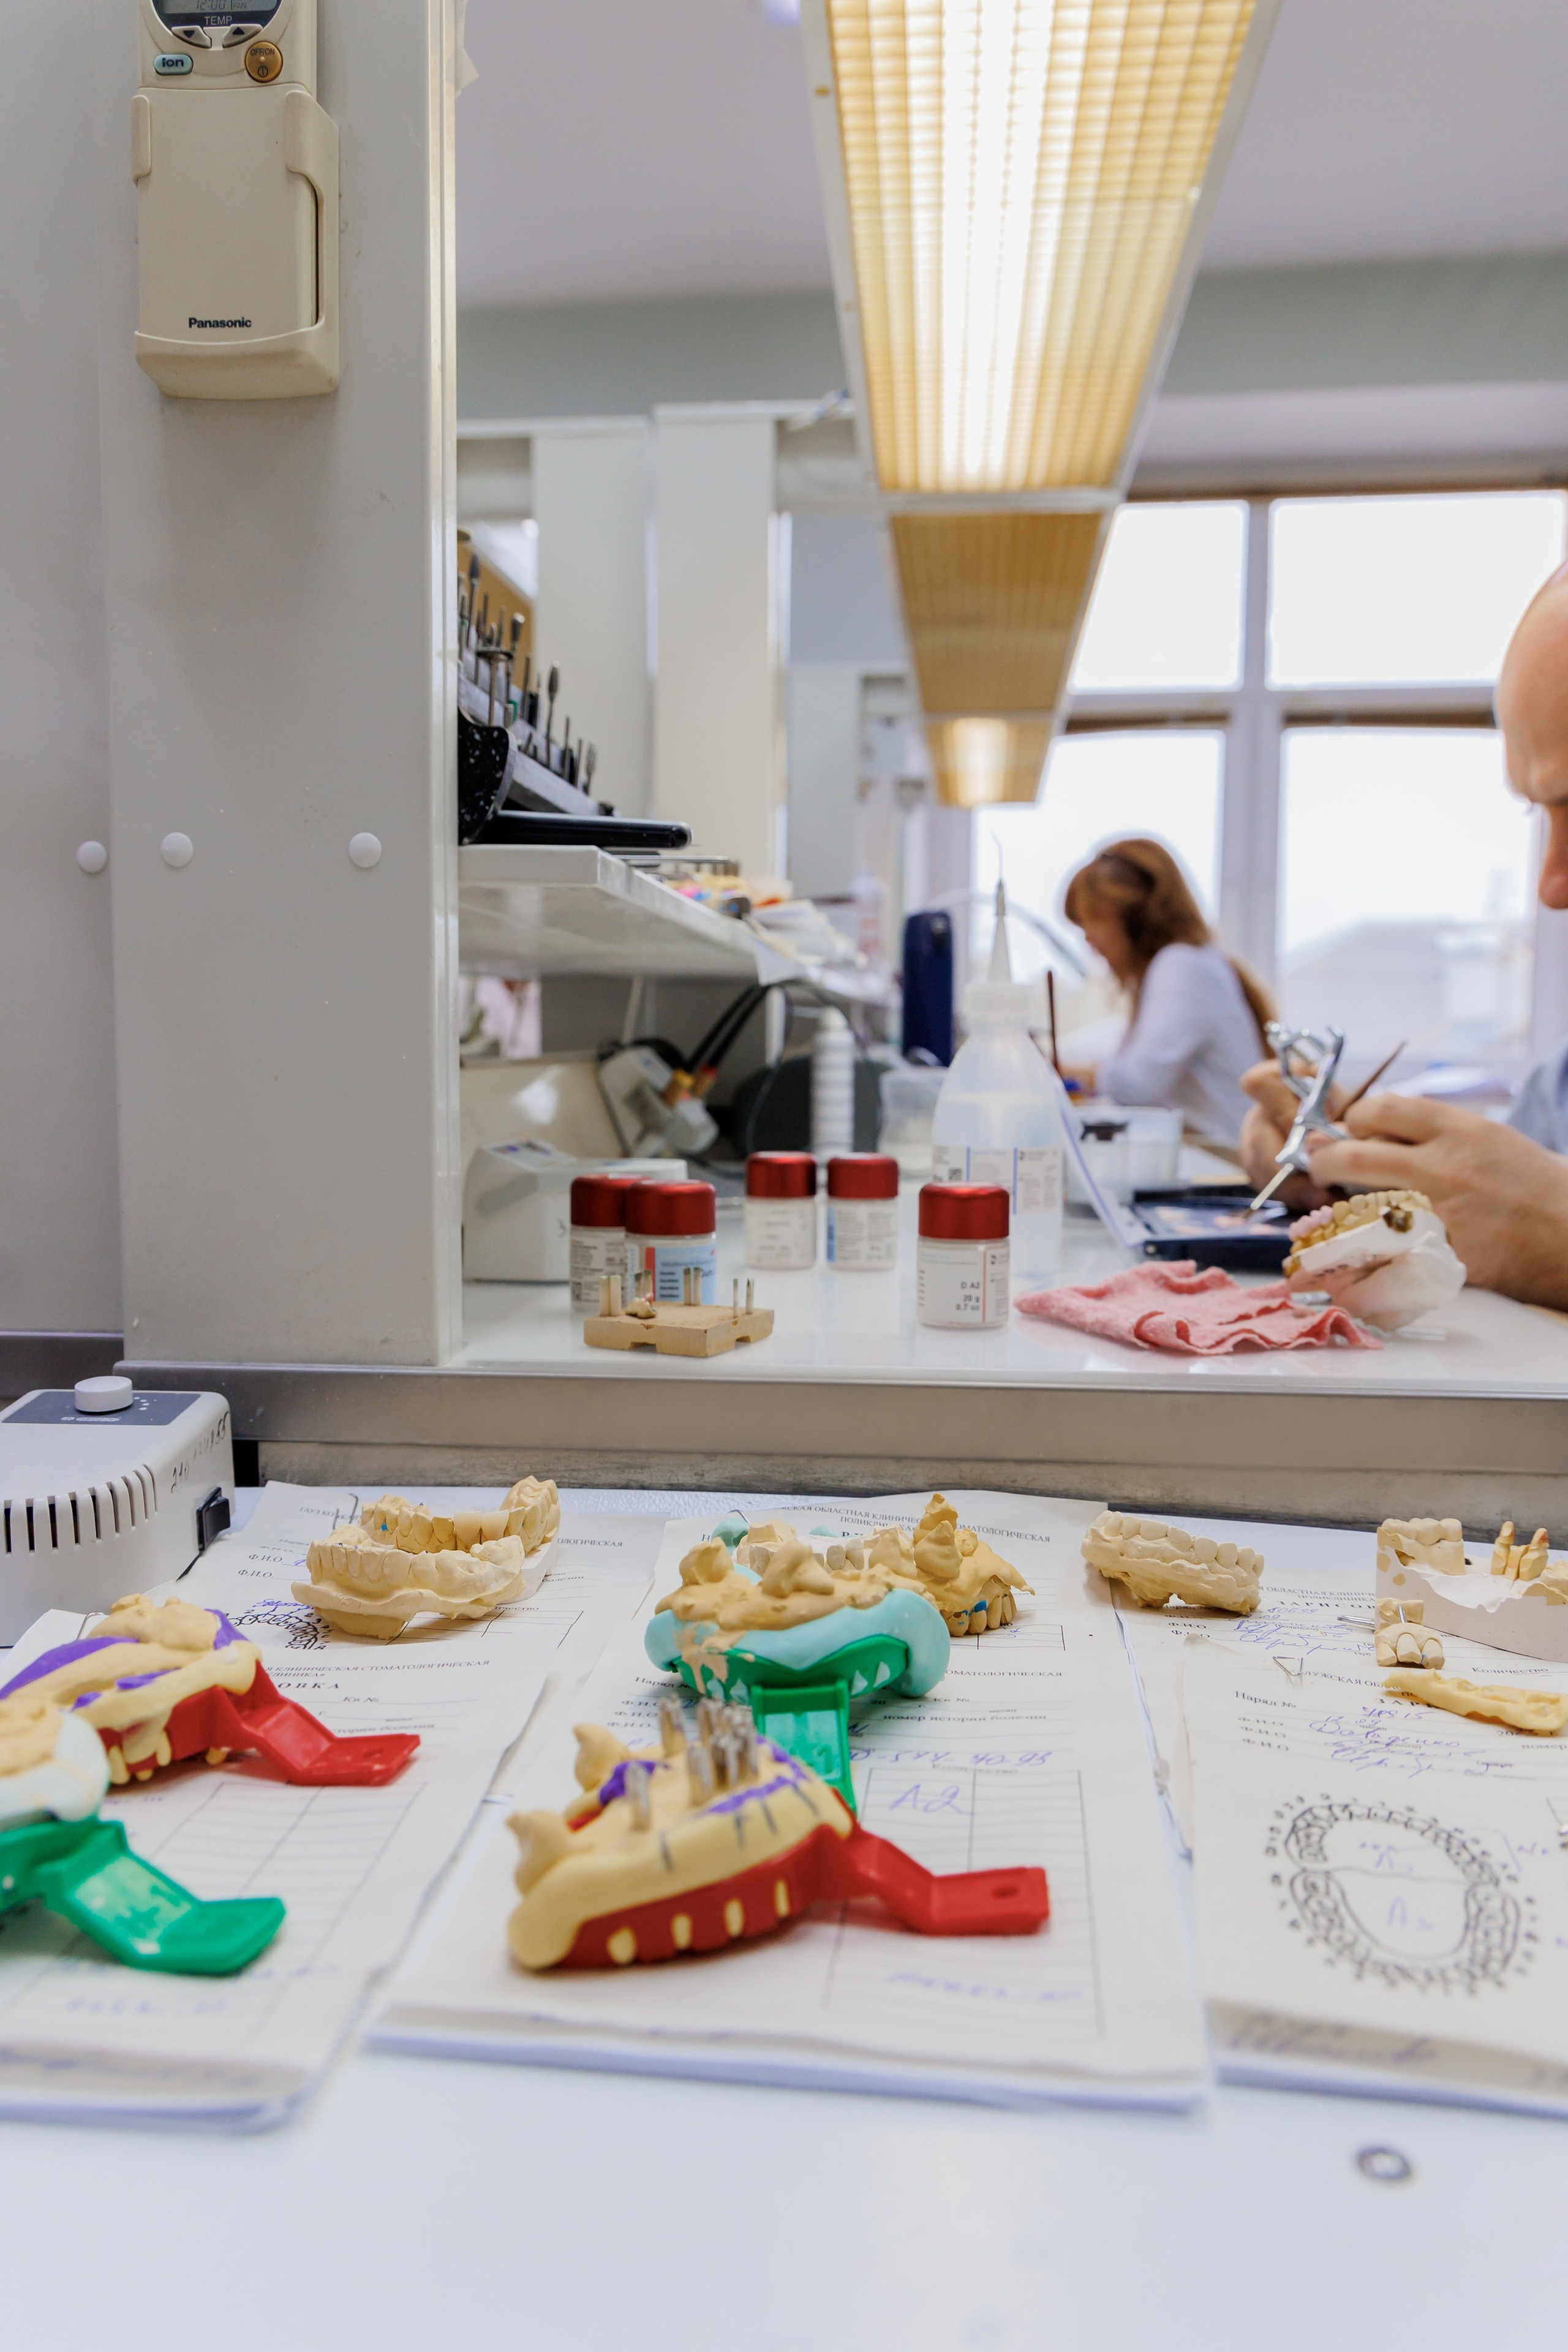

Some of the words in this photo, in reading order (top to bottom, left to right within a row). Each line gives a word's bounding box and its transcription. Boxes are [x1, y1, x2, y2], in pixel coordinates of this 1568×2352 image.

[205, 16, 232, 25] TEMP
[162, 58, 184, 67] ion
[189, 317, 252, 328] Panasonic
[815, 1506, 870, 1518] ОБЛАСТНАЯ
[248, 1554, 284, 1563] Ф.И.О.
[238, 1569, 273, 1578] Ф.И.О.
[1168, 1622, 1210, 1630] Ф.И.О.
[361, 1660, 490, 1671] СТОМАТОЛОГИЧЕСКАЯ
[1472, 1666, 1548, 1675] Количество
[1235, 1691, 1278, 1706] Наряд
